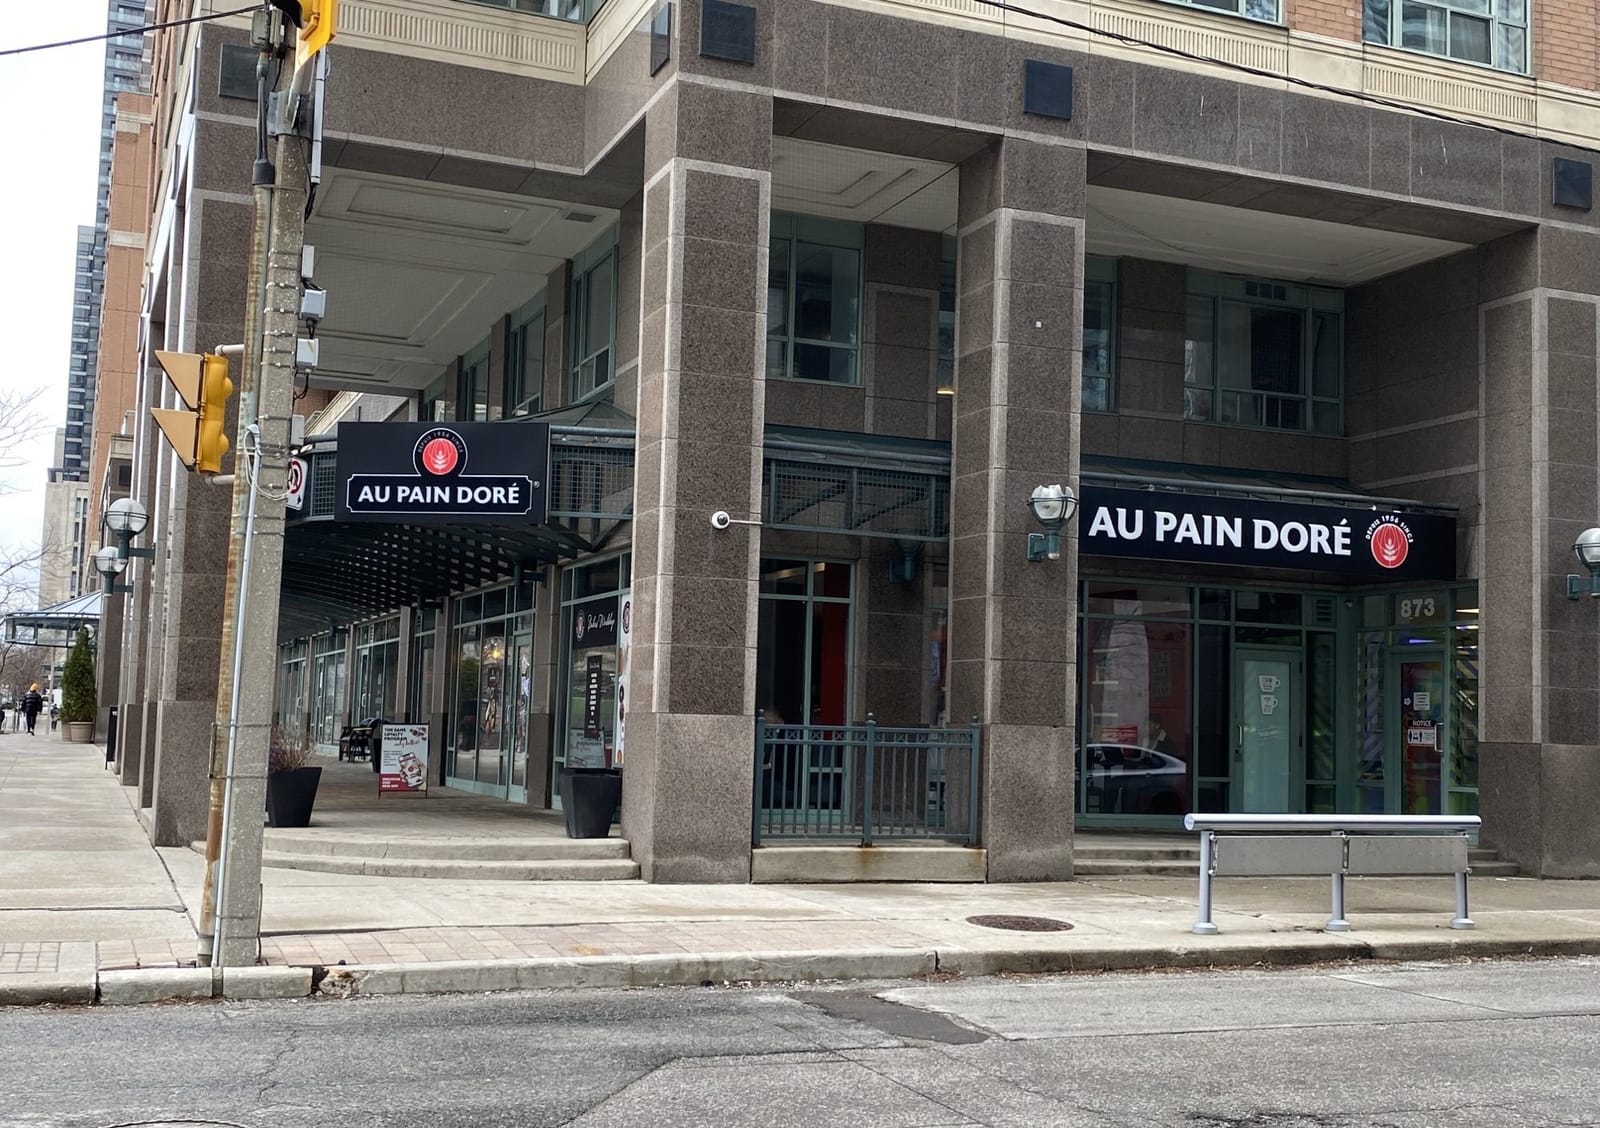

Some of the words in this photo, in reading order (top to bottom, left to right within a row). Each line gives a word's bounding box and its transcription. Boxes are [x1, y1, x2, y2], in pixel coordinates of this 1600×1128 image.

[358, 485, 391, 503] AU
[397, 485, 450, 504] PAIN
[457, 482, 520, 504] DORÉ
[1088, 506, 1144, 540] AU
[1154, 510, 1242, 548] PAIN
[1252, 518, 1352, 556] DORÉ
[1365, 518, 1381, 540] DEPUIS
[1381, 515, 1399, 523] 1956
[1400, 522, 1414, 543] SINCE
[1401, 598, 1435, 618] 873
